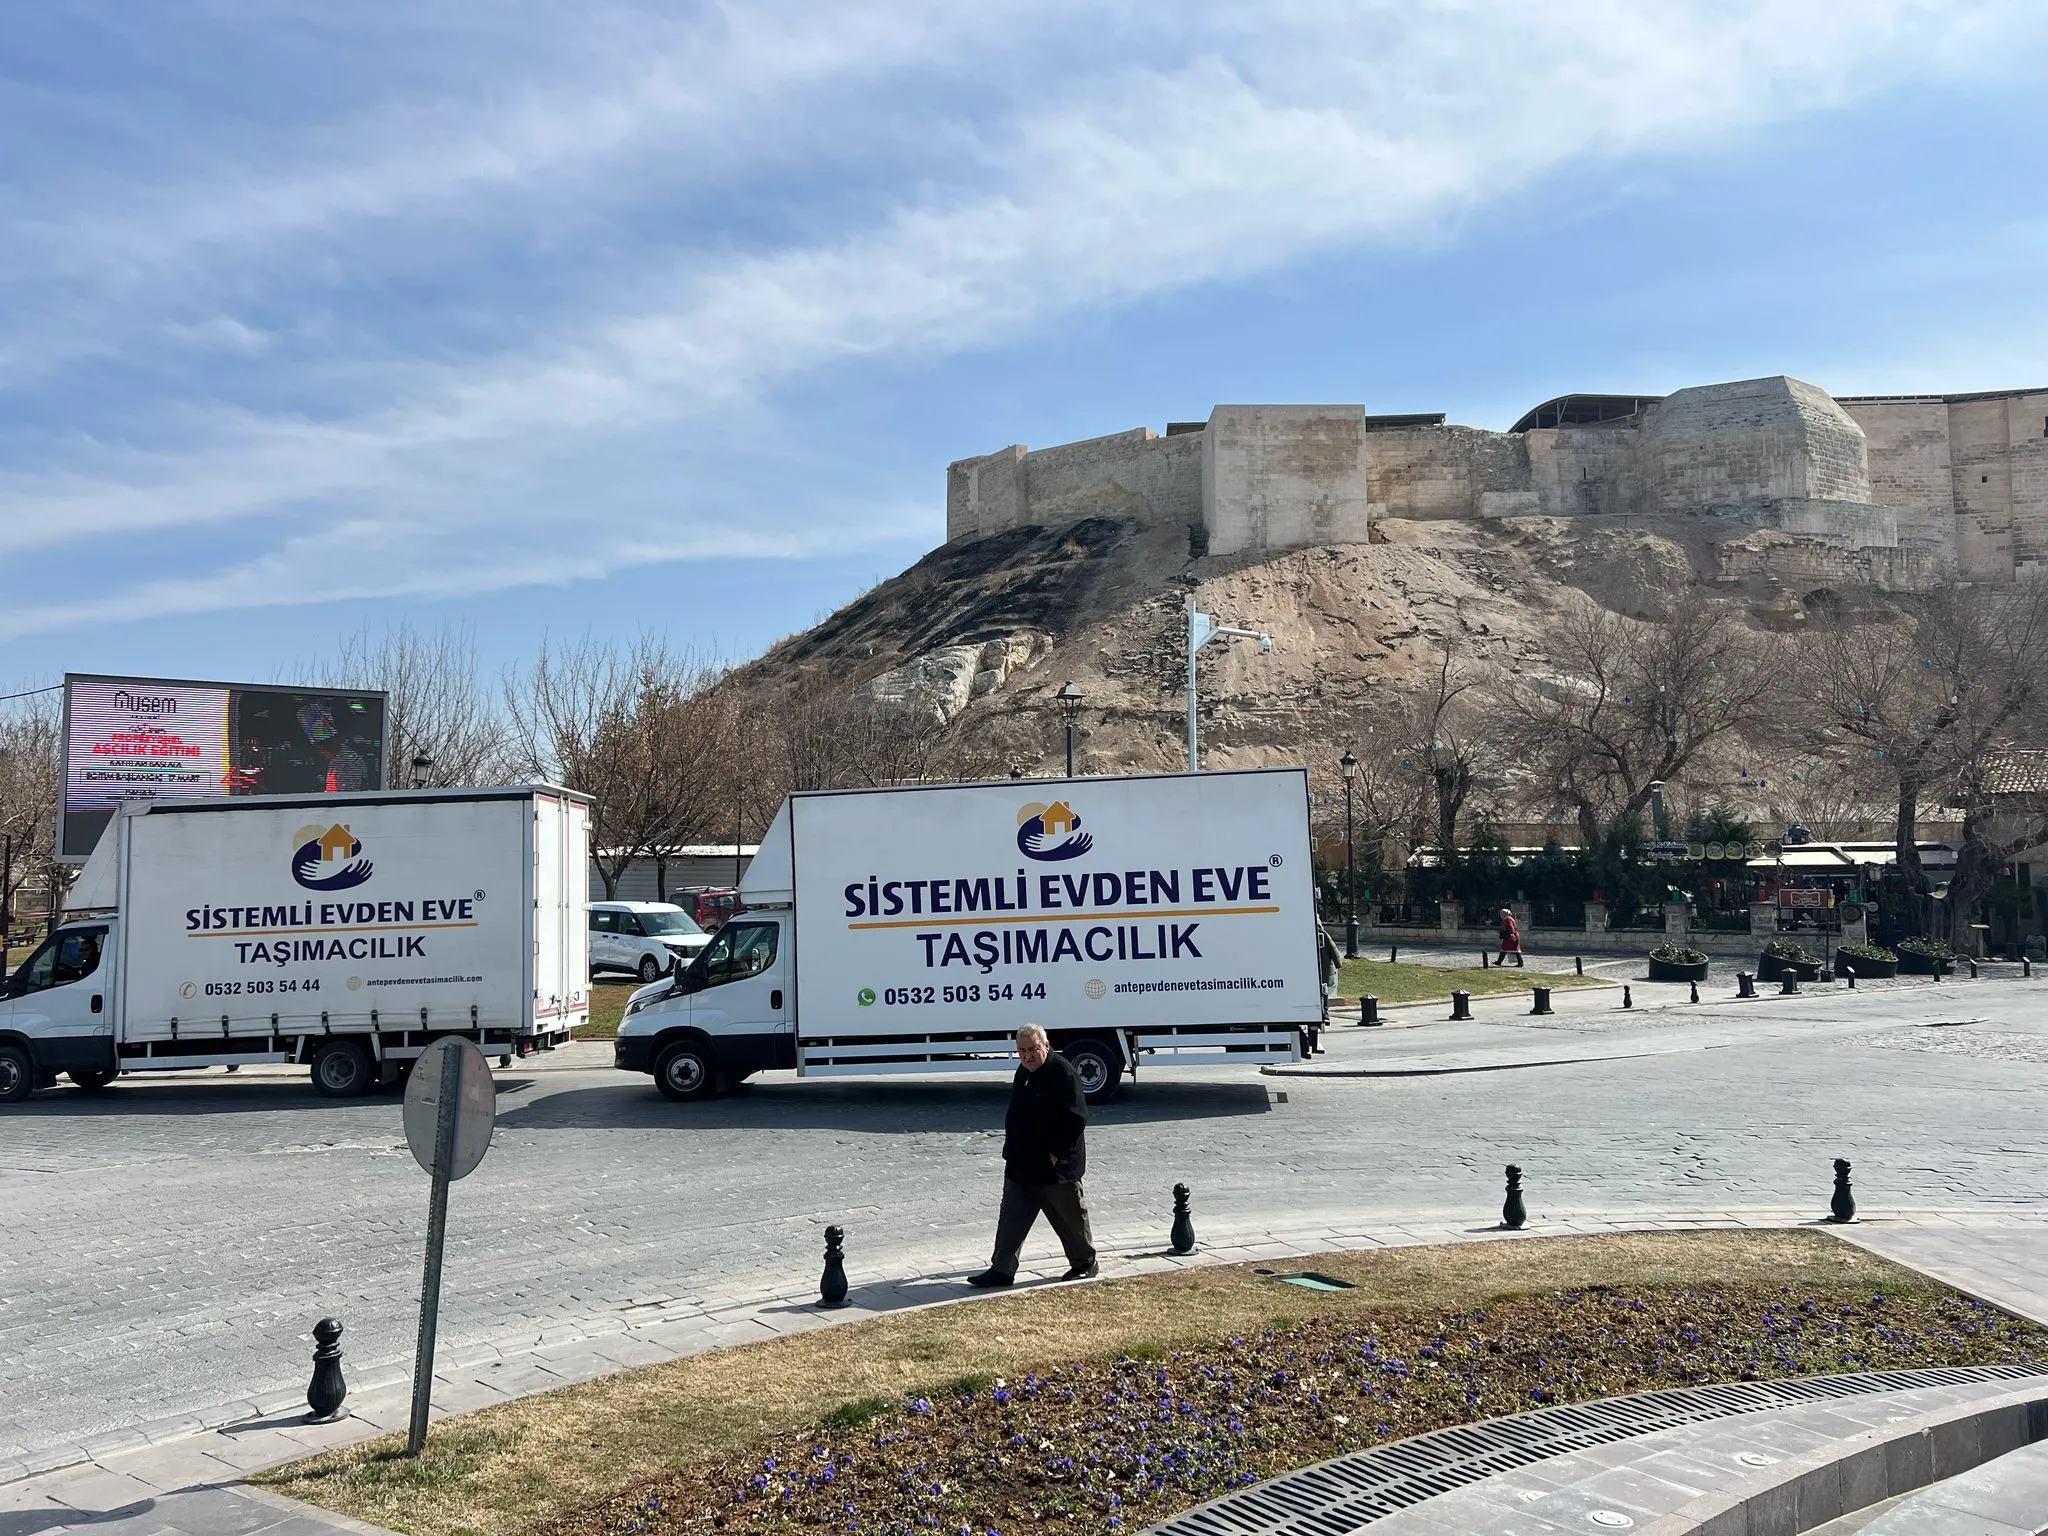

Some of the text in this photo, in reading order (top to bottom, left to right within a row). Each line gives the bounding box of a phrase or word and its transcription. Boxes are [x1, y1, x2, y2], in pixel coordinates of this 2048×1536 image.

[844, 868, 1028, 918] SİSTEMLİ
[1039, 869, 1180, 909] EVDEN
[1192, 865, 1272, 901] EVE
[185, 900, 312, 931] SİSTEMLİ
[320, 900, 414, 925] EVDEN
[422, 898, 473, 921] EVE
[234, 934, 427, 968] TAŞIMACILIK
[916, 922, 1203, 975] TAŞIMACILIK
[204, 978, 321, 996] 0532 503 54 44
[366, 975, 483, 987] antepevdenevetasimacilik.com
[884, 982, 1047, 1006] 0532 503 54 44
[1114, 977, 1284, 995] antepevdenevetasimacilik.com
